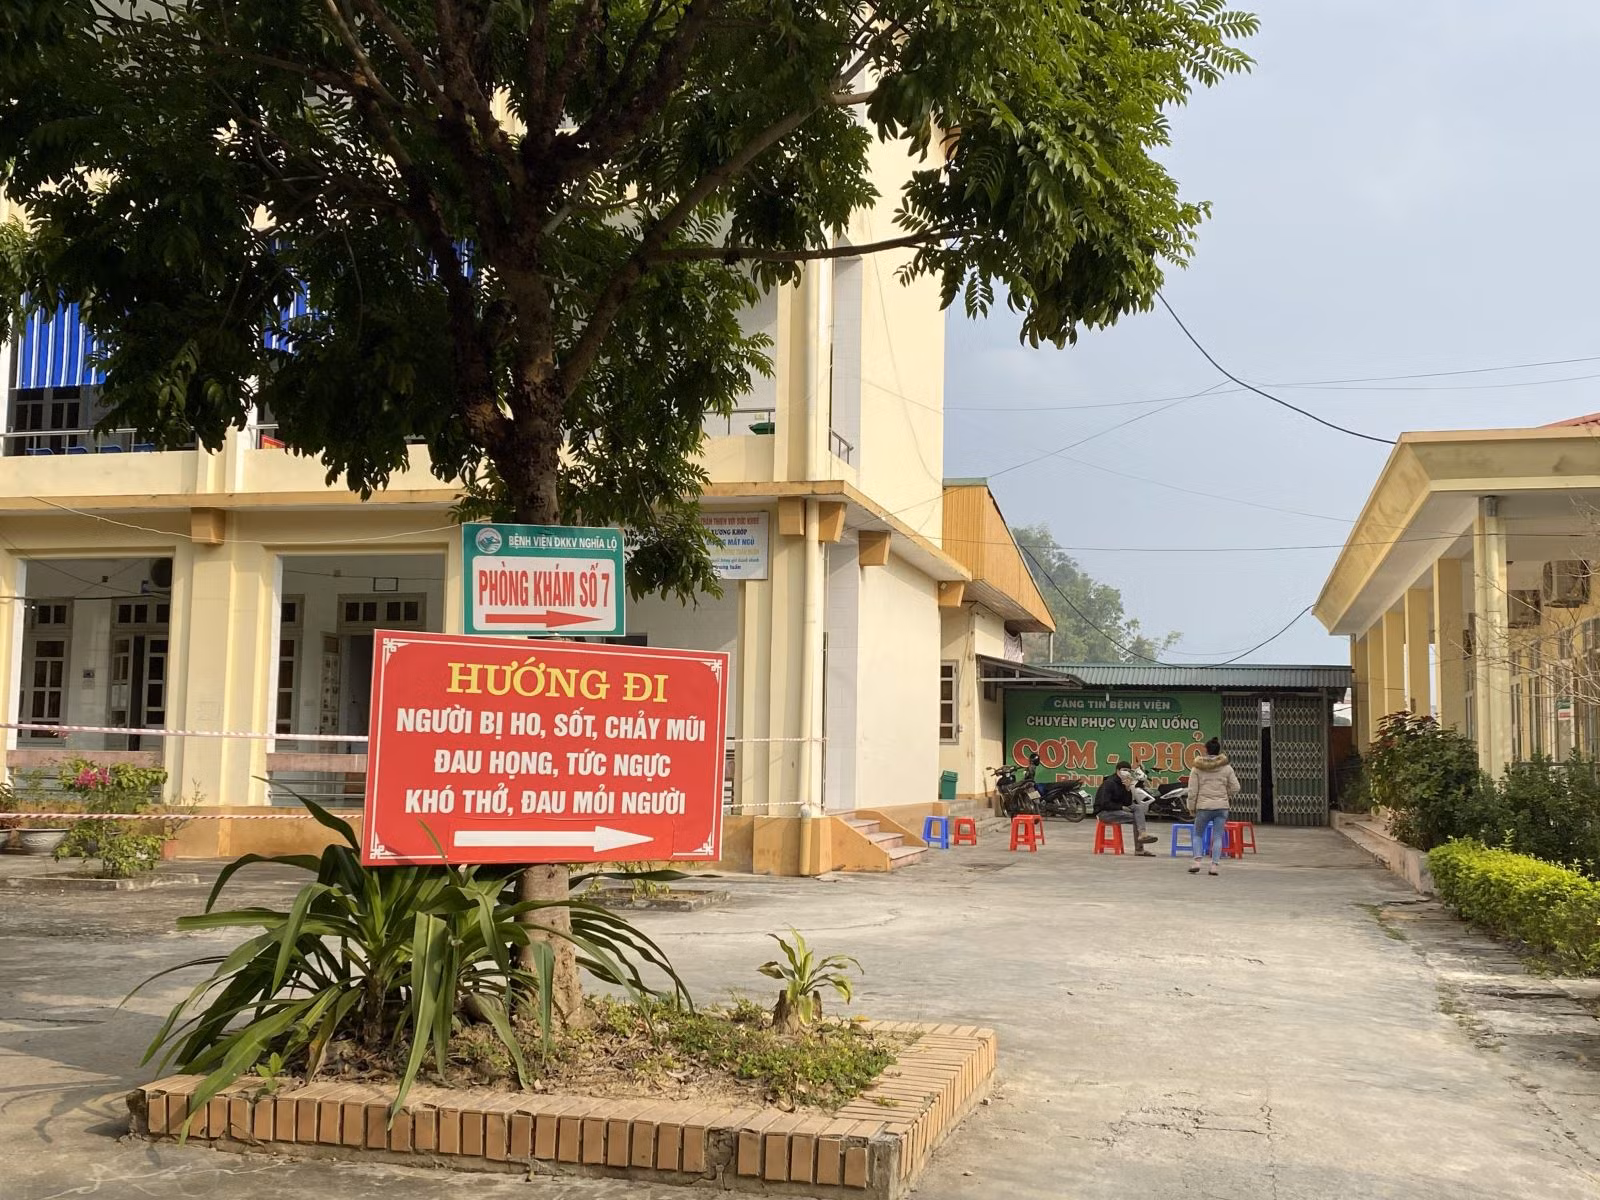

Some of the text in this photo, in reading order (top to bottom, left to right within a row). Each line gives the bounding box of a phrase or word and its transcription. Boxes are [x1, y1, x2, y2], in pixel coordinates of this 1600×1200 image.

[509, 533, 531, 549] BỆNH
[534, 534, 552, 550] VIỆN
[554, 538, 578, 548] ĐKKV
[580, 536, 604, 548] NGHĨA
[607, 536, 618, 552] LỘ
[479, 561, 610, 608] PHÒNG KHÁM SỐ 7
[447, 656, 669, 704] HƯỚNG ĐI
[1088, 700, 1106, 709] TIN
[1110, 699, 1141, 711] BỆNH
[1144, 699, 1170, 711] VIỆN
[396, 704, 706, 742] NGƯỜI BỊ HO, SỐT, CHẢY MŨI
[1027, 714, 1199, 731] CHUYÊN PHỤC VỤ ĂN UỐNG
[434, 748, 672, 782] ĐAU HỌNG, TỨC NGỰC
[1012, 736, 1098, 770] CƠM
[1106, 754, 1120, 764] -
[406, 783, 686, 816] KHÓ THỞ, ĐAU MỎI NGƯỜI
